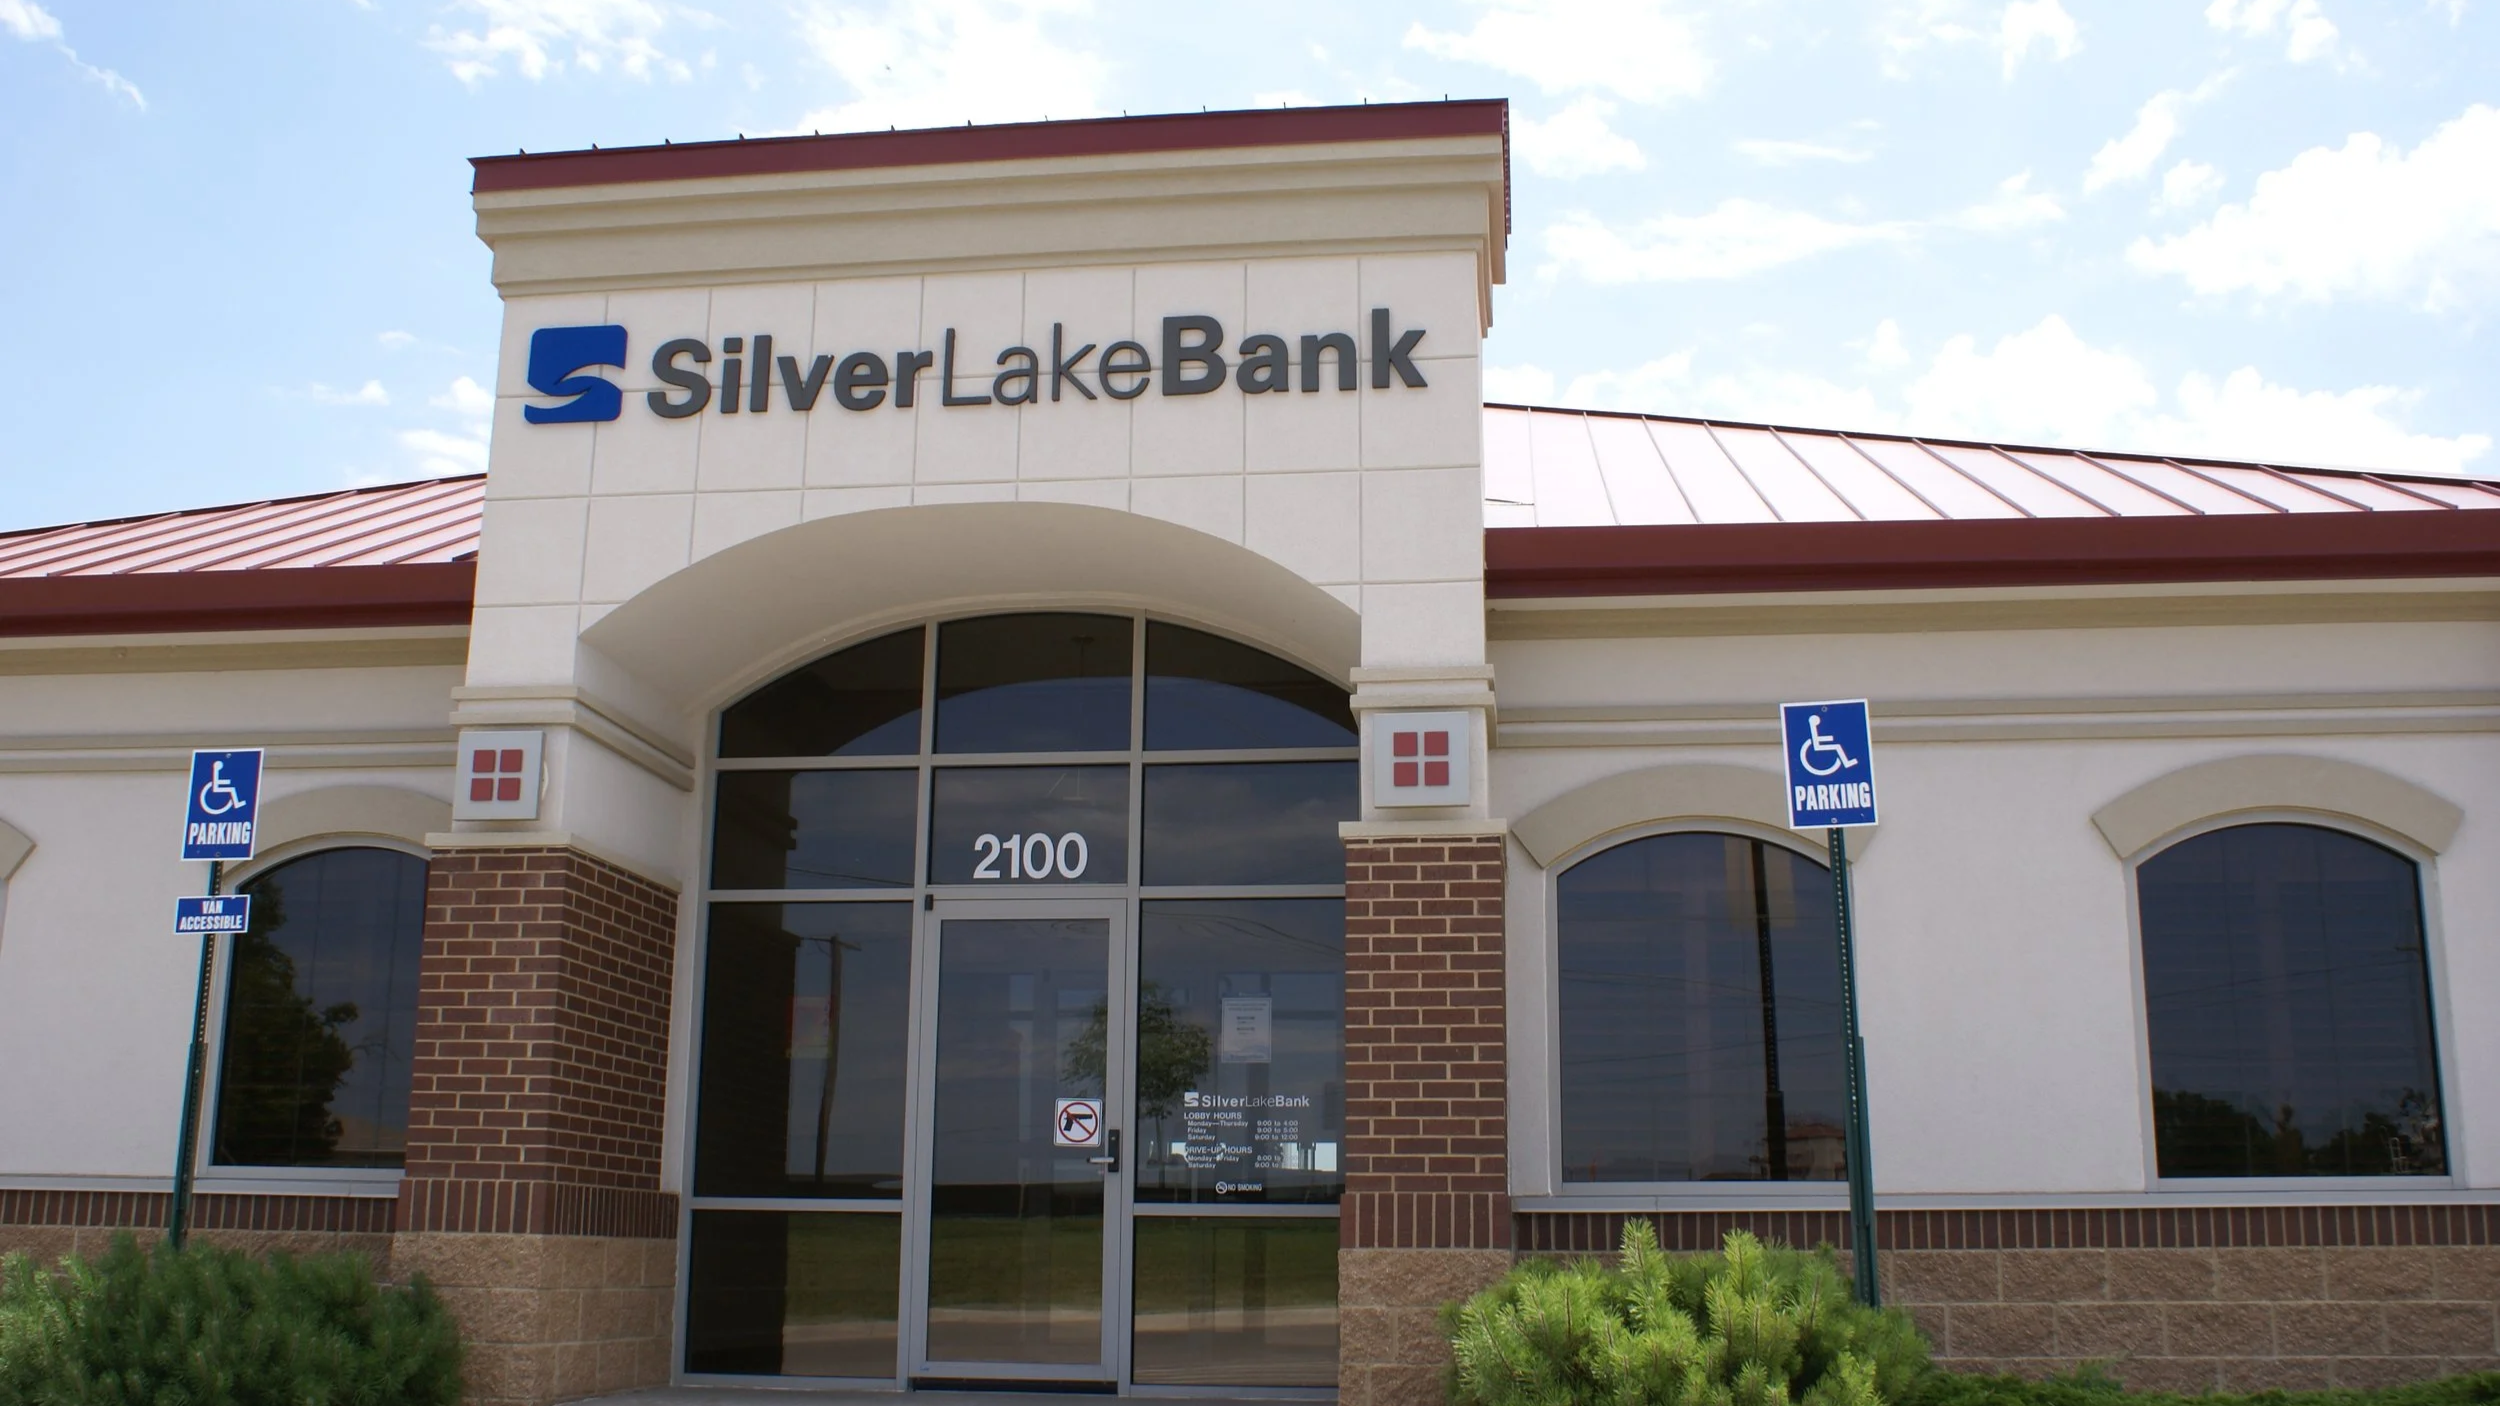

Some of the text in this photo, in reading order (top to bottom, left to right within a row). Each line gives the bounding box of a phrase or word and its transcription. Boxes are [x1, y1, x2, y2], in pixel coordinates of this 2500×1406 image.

[646, 308, 1429, 419] SilverLakeBank
[1794, 782, 1871, 811] PARKING
[188, 822, 251, 845] PARKING
[973, 832, 1088, 879] 2100
[202, 900, 223, 914] VAN
[179, 915, 243, 930] ACCESSIBLE
[1201, 1095, 1310, 1108] SilverLakeBank
[1183, 1112, 1242, 1120] LOBBY HOURS
[1224, 1146, 1253, 1154] HOURS
[1227, 1183, 1262, 1192] NO SMOKING
